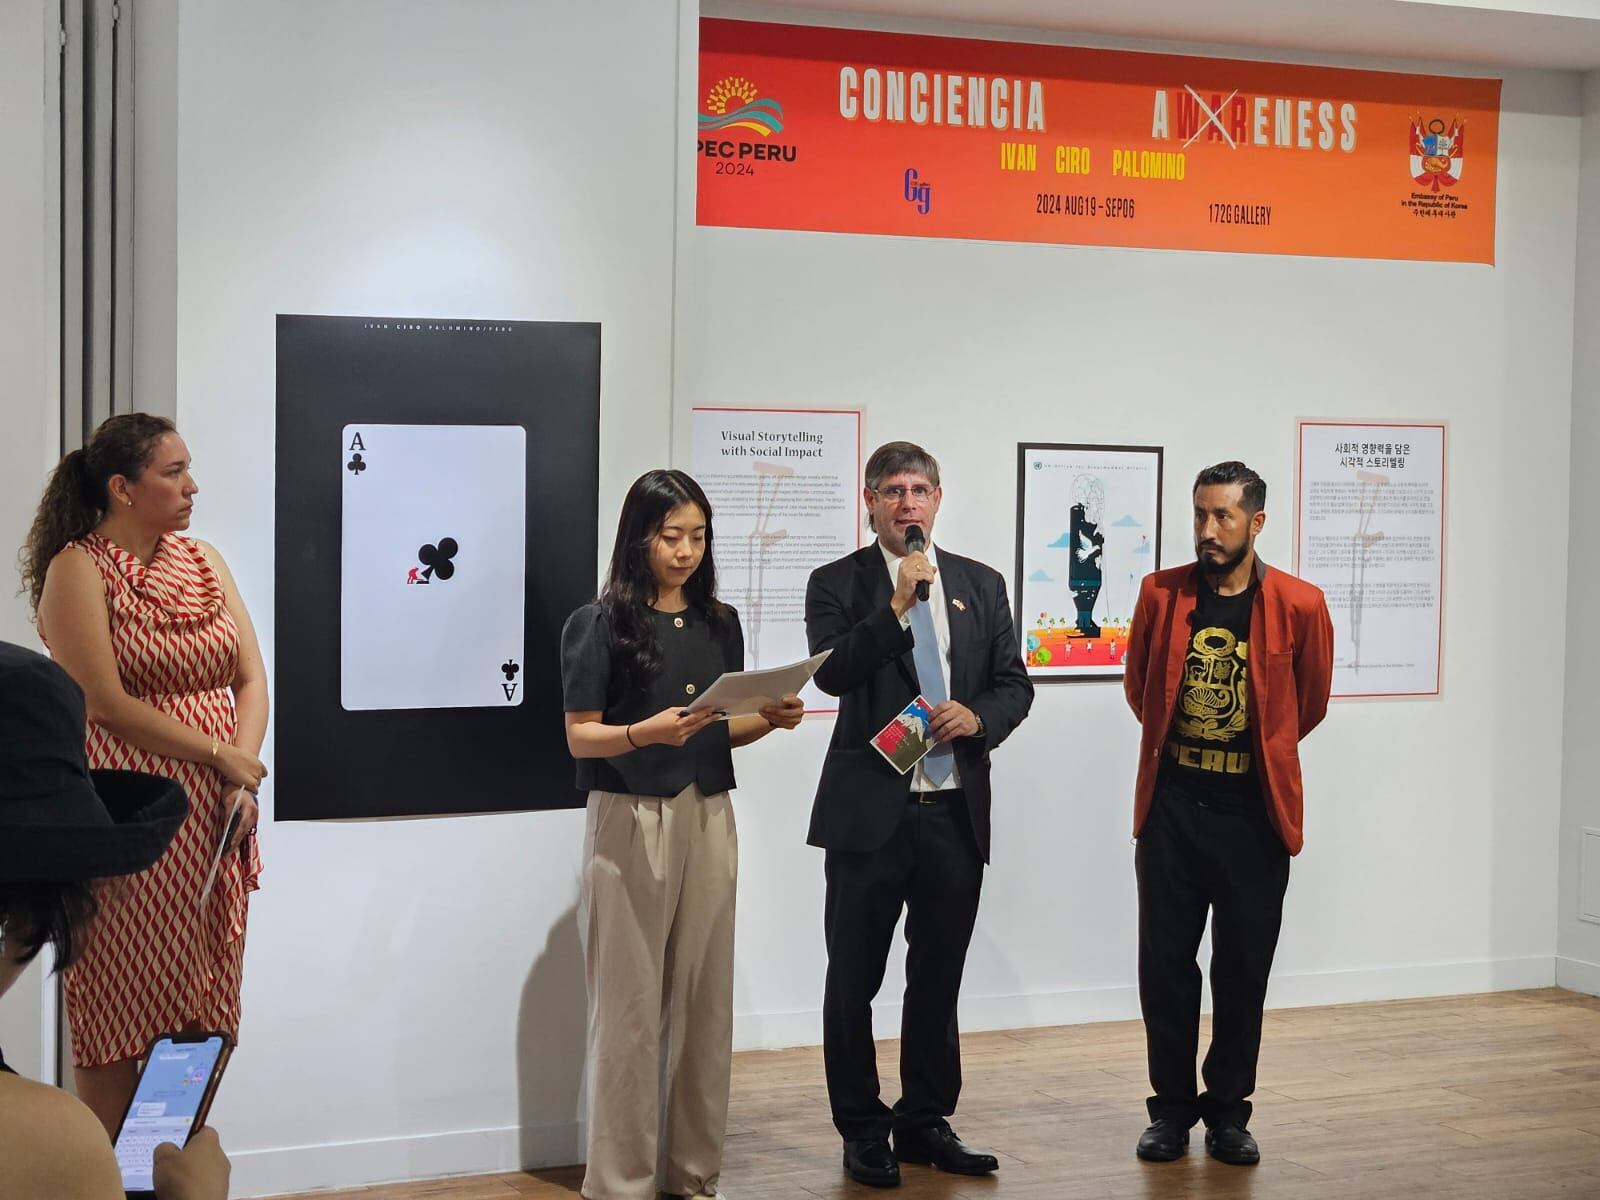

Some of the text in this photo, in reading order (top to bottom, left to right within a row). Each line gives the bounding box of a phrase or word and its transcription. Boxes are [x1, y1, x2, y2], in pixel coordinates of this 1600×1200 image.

[839, 66, 1046, 132] CONCIENCIA
[1151, 88, 1357, 152] AWARENESS
[739, 142, 796, 162] PERU
[1001, 142, 1185, 181] IVAN CIRO PALOMINO
[716, 162, 754, 176] 2024
[1036, 194, 1061, 214] 2024
[1208, 203, 1272, 226] 172G GALLERY
[349, 432, 366, 451] A
[721, 430, 823, 444] Visual Storytelling
[721, 446, 823, 459] with Social Impact
[1335, 443, 1411, 455] 사회적 영향력을 담은
[1340, 457, 1405, 469] 시각적 스토리텔링
[501, 683, 518, 701] A
